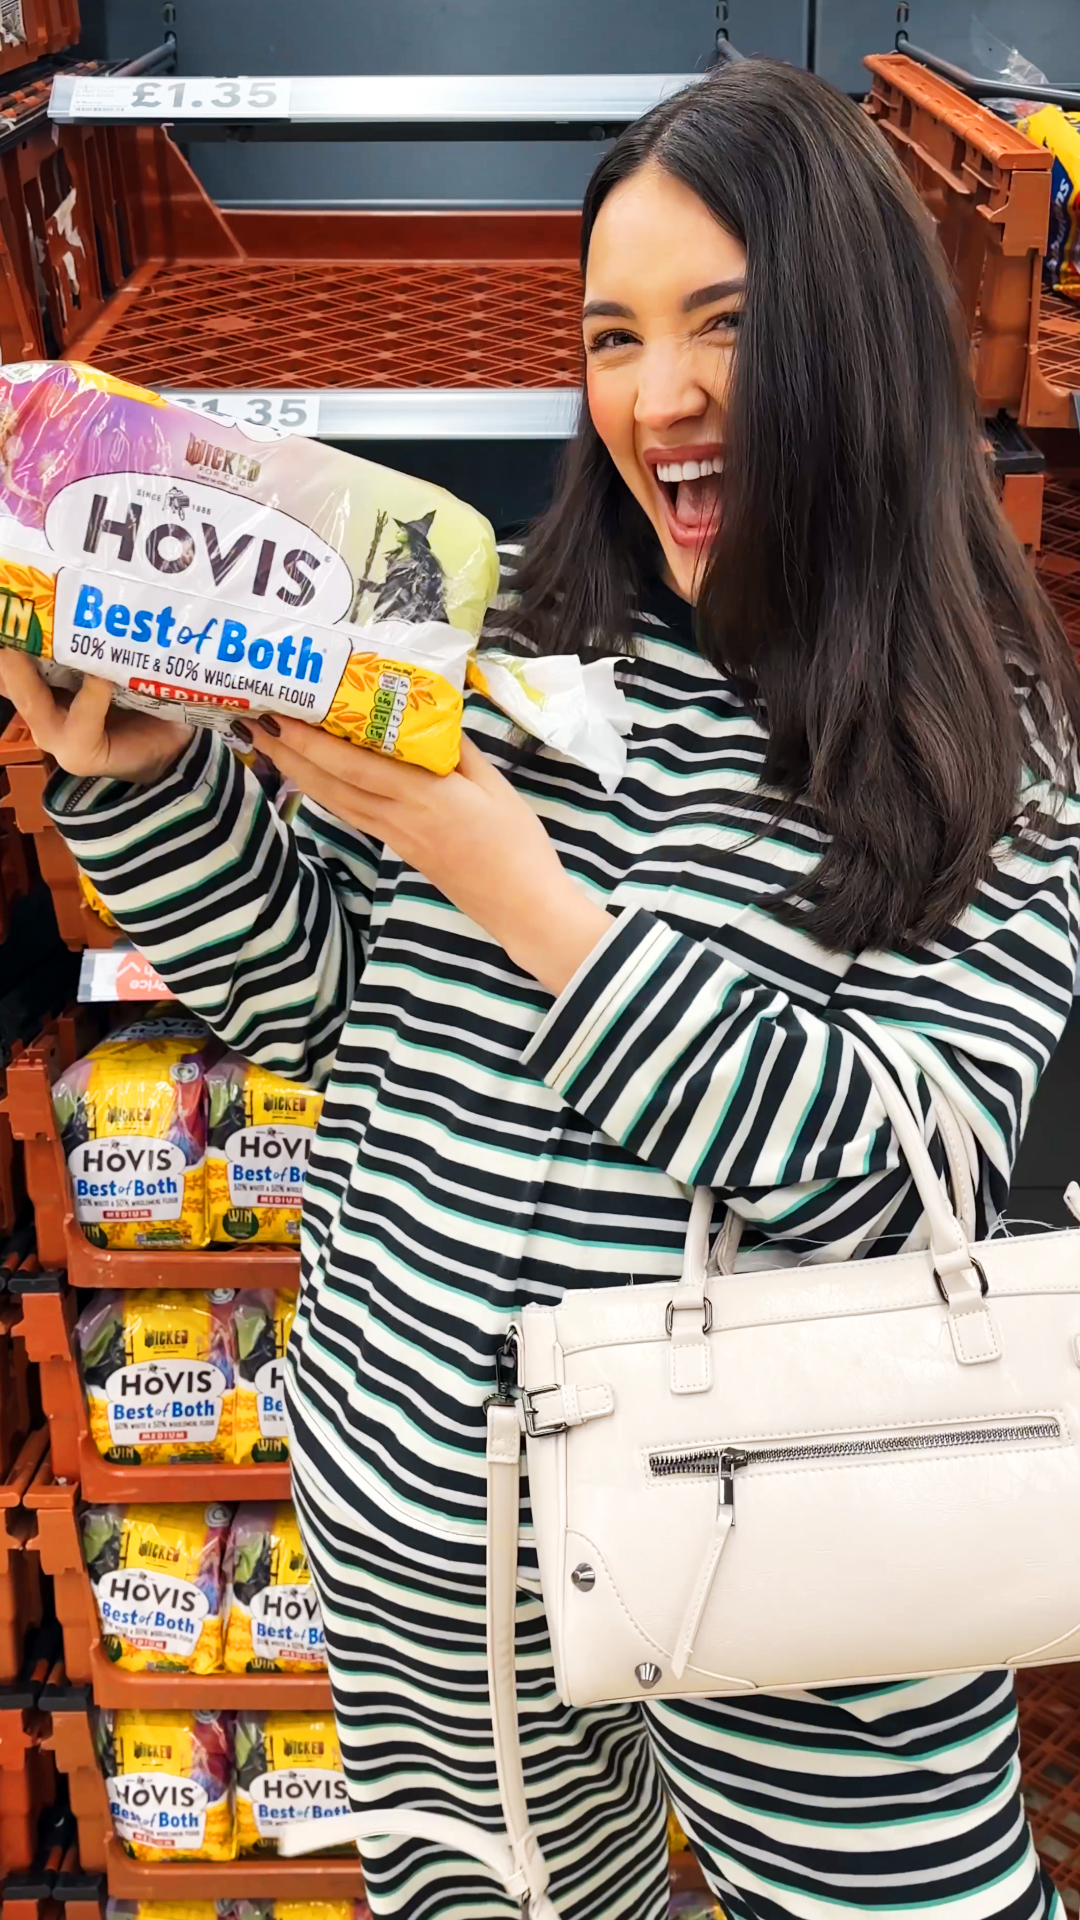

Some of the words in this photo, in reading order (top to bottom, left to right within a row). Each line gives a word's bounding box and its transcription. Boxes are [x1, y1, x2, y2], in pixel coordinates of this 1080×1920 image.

[131, 82, 277, 108] £1.35
[185, 432, 261, 482] WICKED
[137, 489, 162, 502] SINCE
[73, 584, 176, 648] Best
[177, 617, 218, 654] of
[217, 619, 323, 684] Both
[70, 633, 107, 660] 50%
[111, 646, 150, 670] WHITE
[152, 657, 161, 673] &
[165, 655, 200, 682] 50%
[204, 668, 275, 697] WHOLEMEAL
[278, 685, 316, 709] FLOUR
[240, 1136, 311, 1160] HOVI
[233, 1164, 272, 1182] Best
[273, 1167, 288, 1182] of
[77, 1179, 116, 1196] Best
[118, 1180, 133, 1196] of
[134, 1177, 177, 1196] Both
[259, 1196, 302, 1205] MEDIUM
[105, 1210, 149, 1219] MEDIUM
[228, 1209, 252, 1224] WIN
[144, 1328, 189, 1348] WICKED
[113, 1403, 154, 1420] Best
[155, 1403, 170, 1419] of
[172, 1400, 215, 1418] Both
[141, 1431, 186, 1440] MEDIUM
[103, 1601, 138, 1625] Best
[139, 1611, 154, 1625] of
[155, 1612, 194, 1634] Both
[257, 1622, 293, 1640] Best
[159, 1812, 199, 1828] Both
[258, 1804, 296, 1819] Best
